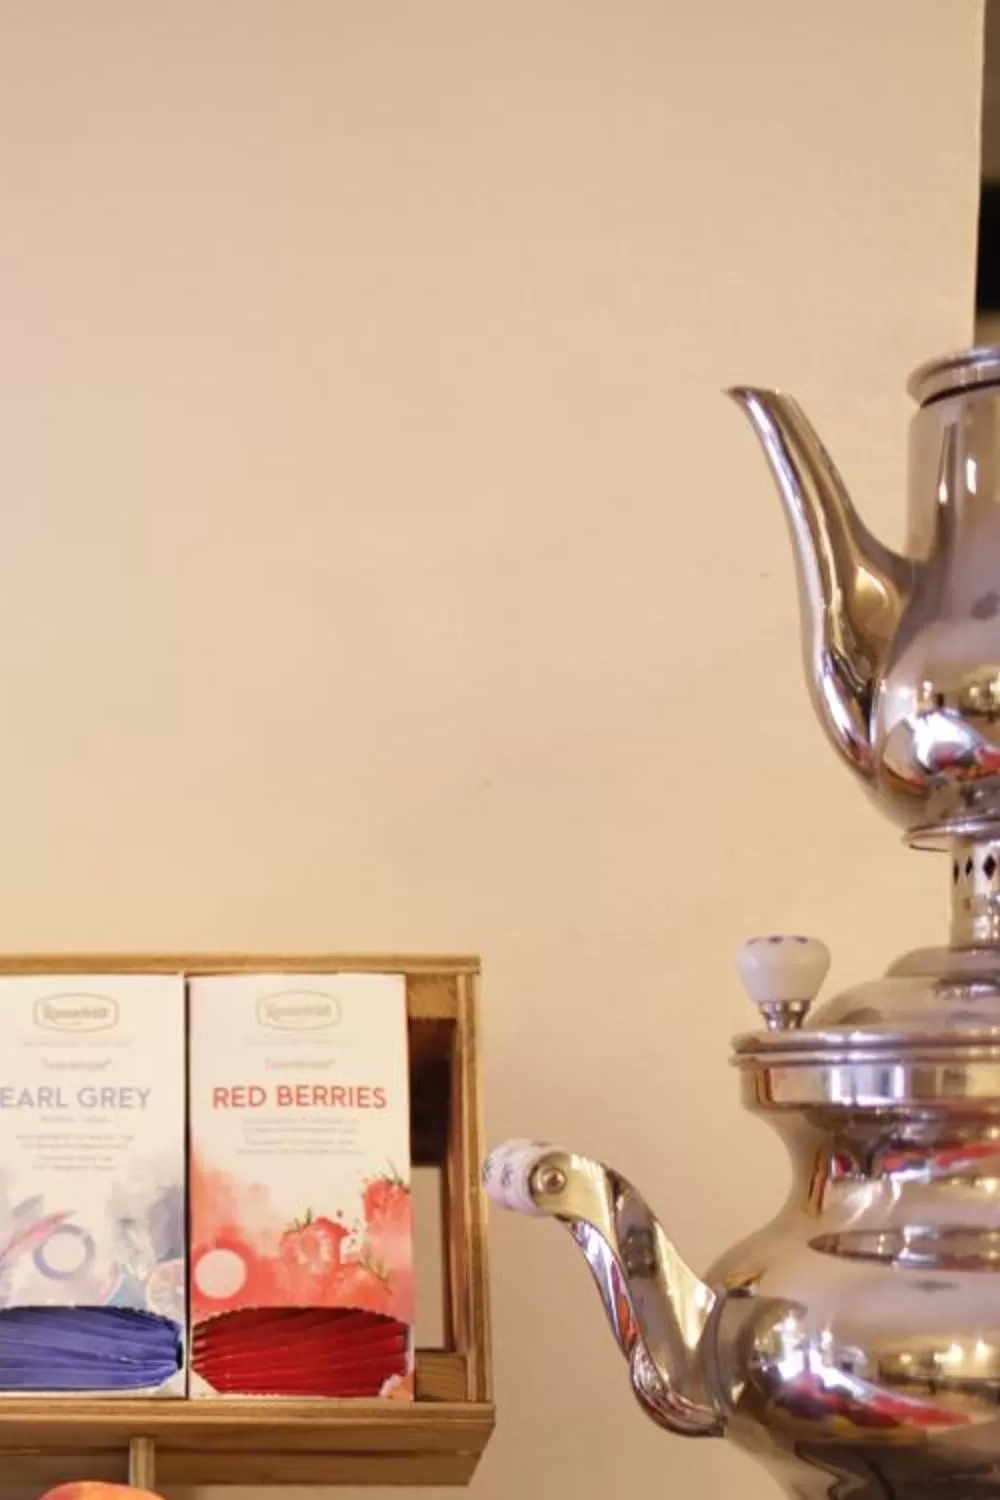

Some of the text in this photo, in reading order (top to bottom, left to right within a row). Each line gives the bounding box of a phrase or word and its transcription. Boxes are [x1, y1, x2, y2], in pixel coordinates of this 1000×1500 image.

[76, 1085, 152, 1109] GREY
[212, 1084, 387, 1110] RED BERRIES
